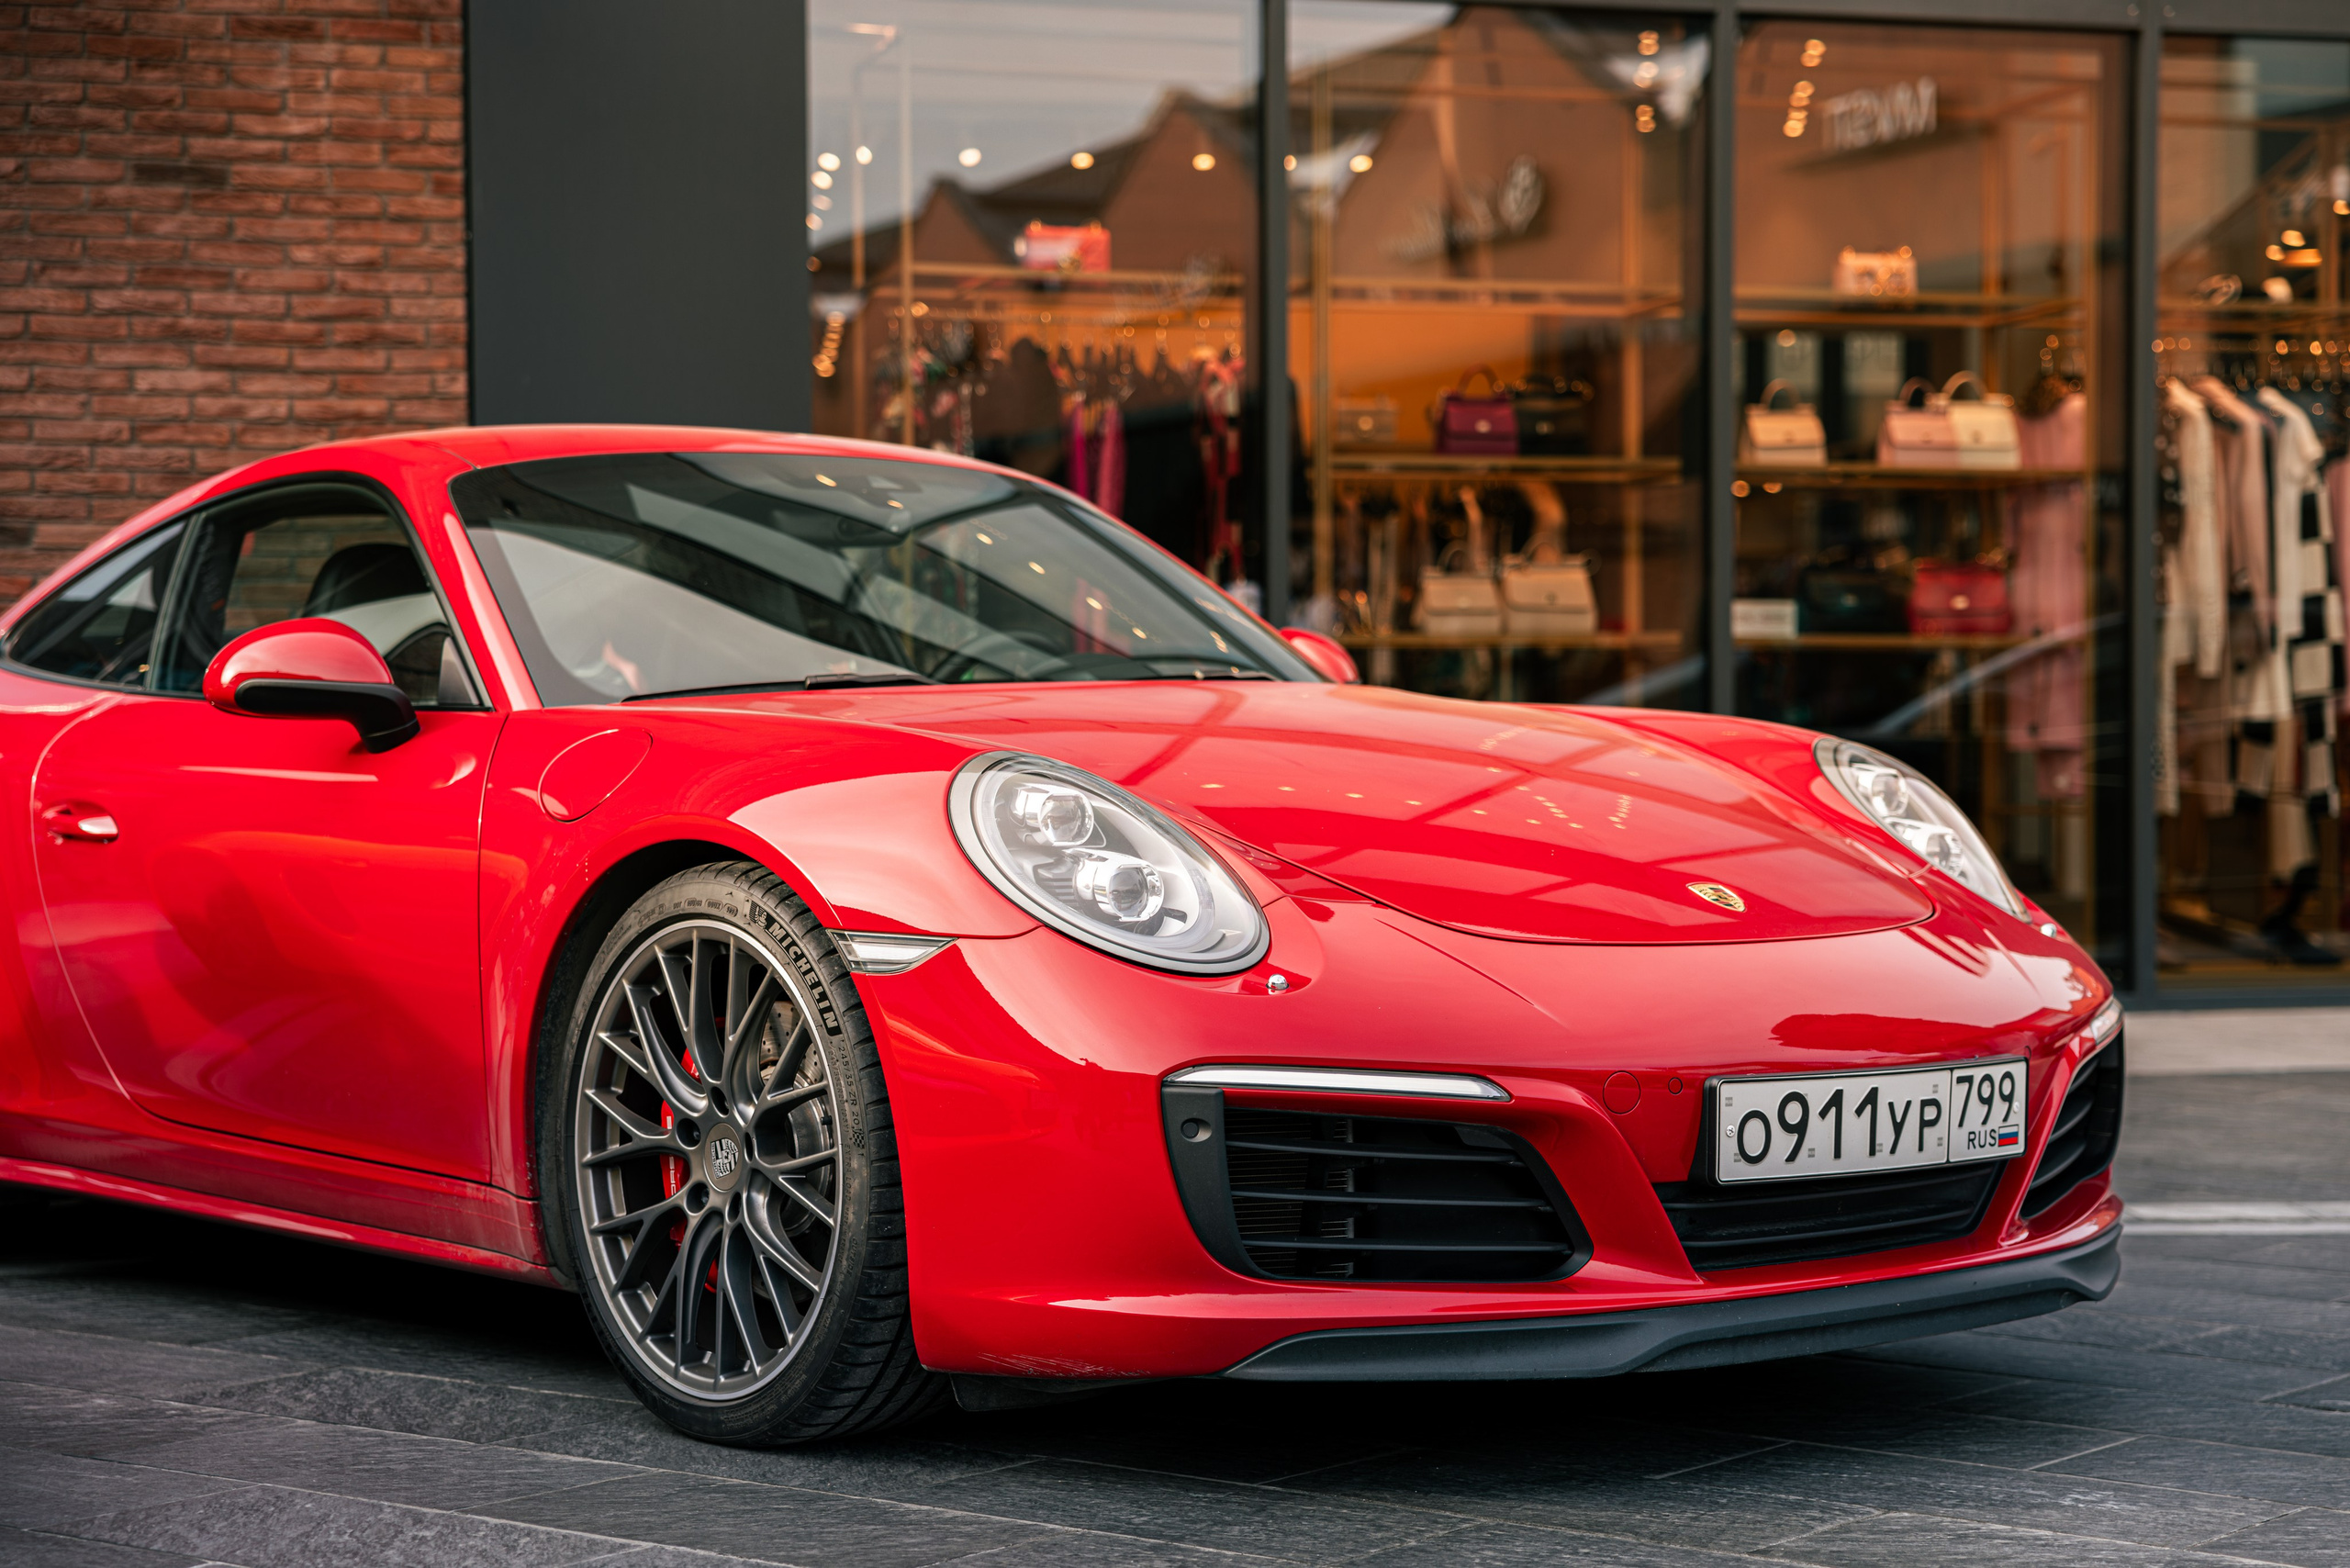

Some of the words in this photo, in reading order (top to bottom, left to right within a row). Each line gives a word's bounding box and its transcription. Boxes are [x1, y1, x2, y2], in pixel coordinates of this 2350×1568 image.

[769, 922, 839, 1028] MICHELIN
[838, 1047, 855, 1087] 245/35
[848, 1091, 858, 1106] ZR
[852, 1111, 861, 1126] 20
[1956, 1071, 2015, 1129] 799
[1967, 1128, 1997, 1151] RUS
[847, 1238, 858, 1278] OUTSIDE
